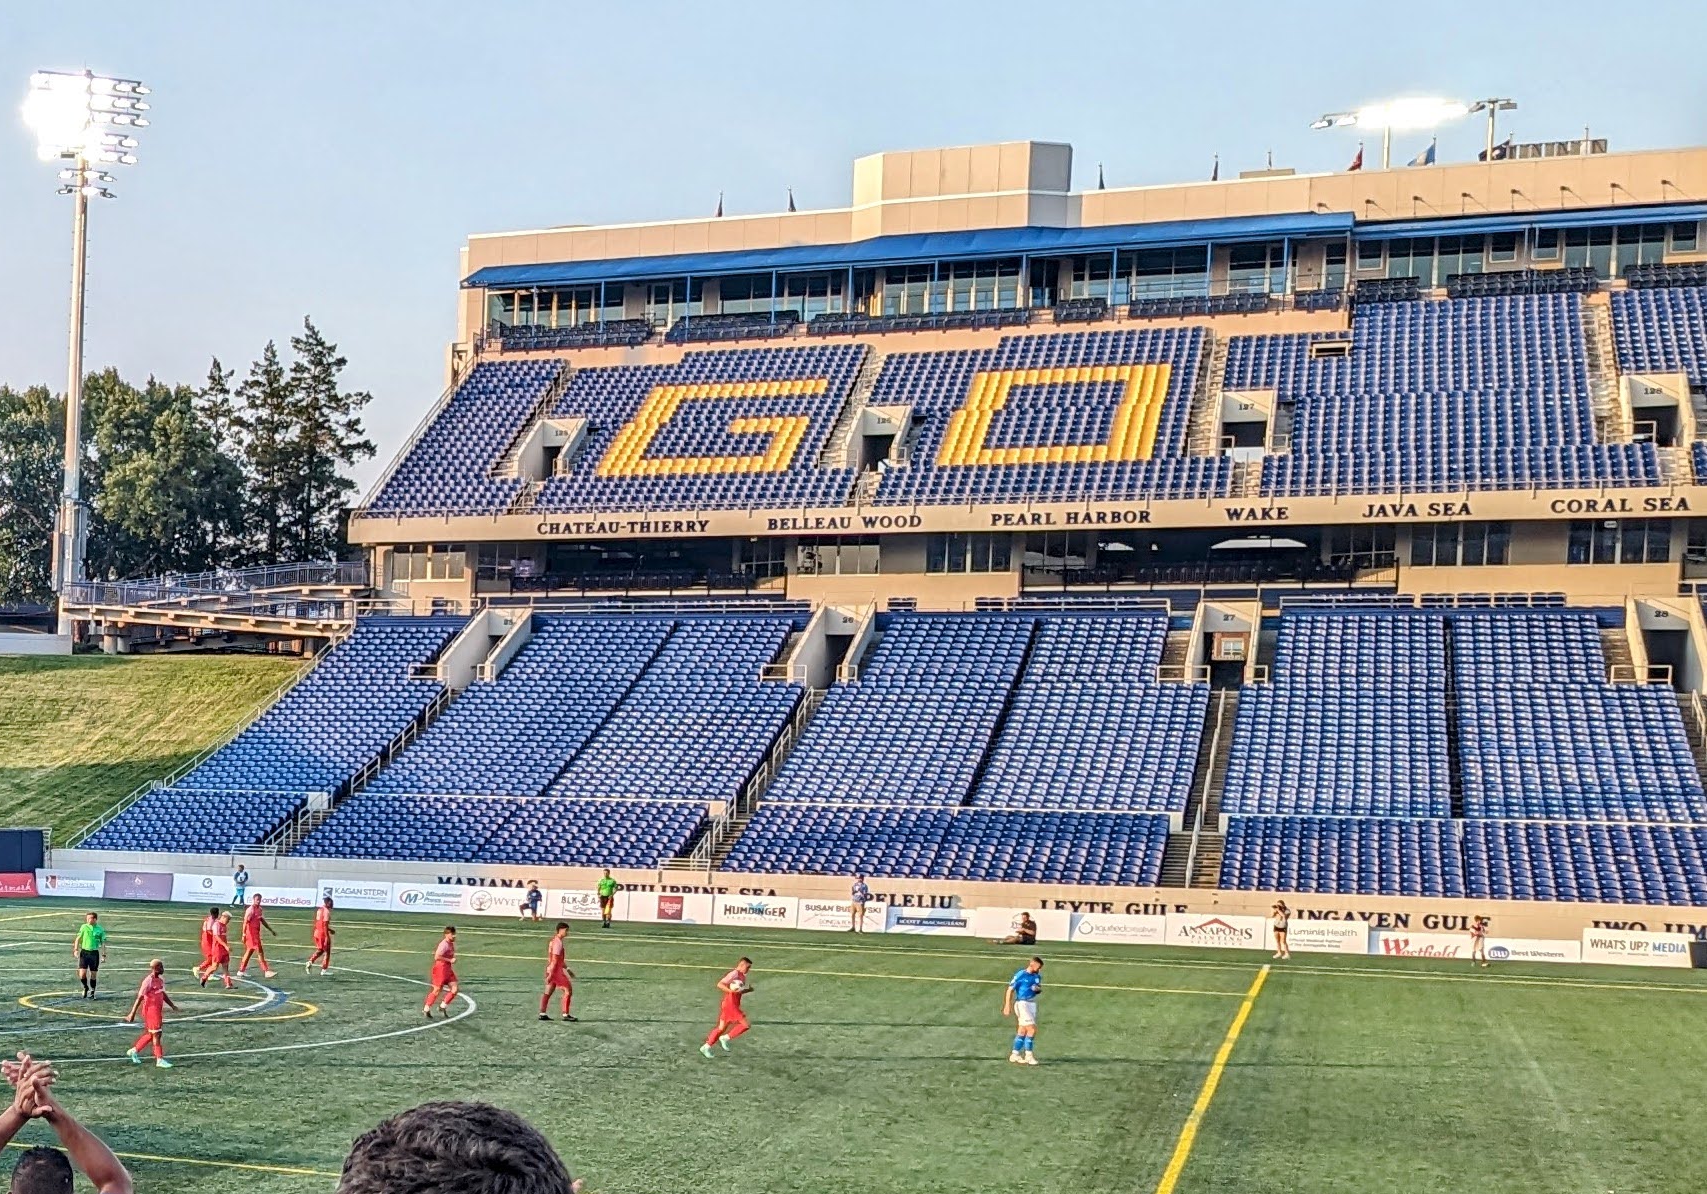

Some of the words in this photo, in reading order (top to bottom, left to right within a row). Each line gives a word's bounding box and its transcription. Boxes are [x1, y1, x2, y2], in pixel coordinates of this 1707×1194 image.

[1362, 502, 1418, 518] JAVA
[1427, 502, 1472, 517] SEA
[1550, 497, 1634, 514] CORAL
[1643, 497, 1691, 512] SEA
[990, 512, 1057, 526] PEARL
[1065, 510, 1151, 525] HARBOR
[1224, 506, 1289, 521] WAKE
[536, 520, 711, 536] CHATEAU-THIERRY
[766, 516, 852, 531] BELLEAU
[862, 514, 922, 529] WOOD
[334, 888, 363, 896] KAGAN
[363, 888, 388, 897] STERN
[280, 897, 311, 906] Studios
[805, 904, 835, 912] SUSAN
[864, 893, 954, 909] PELELIU
[723, 904, 787, 918] HUMDINGER
[1296, 909, 1411, 929] INGAYEN
[1178, 925, 1253, 940] ANNAPOLIS
[1327, 928, 1358, 938] Health
[1530, 950, 1564, 958] Western
[1629, 940, 1649, 951] UP?
[1652, 942, 1687, 954] MEDIA
